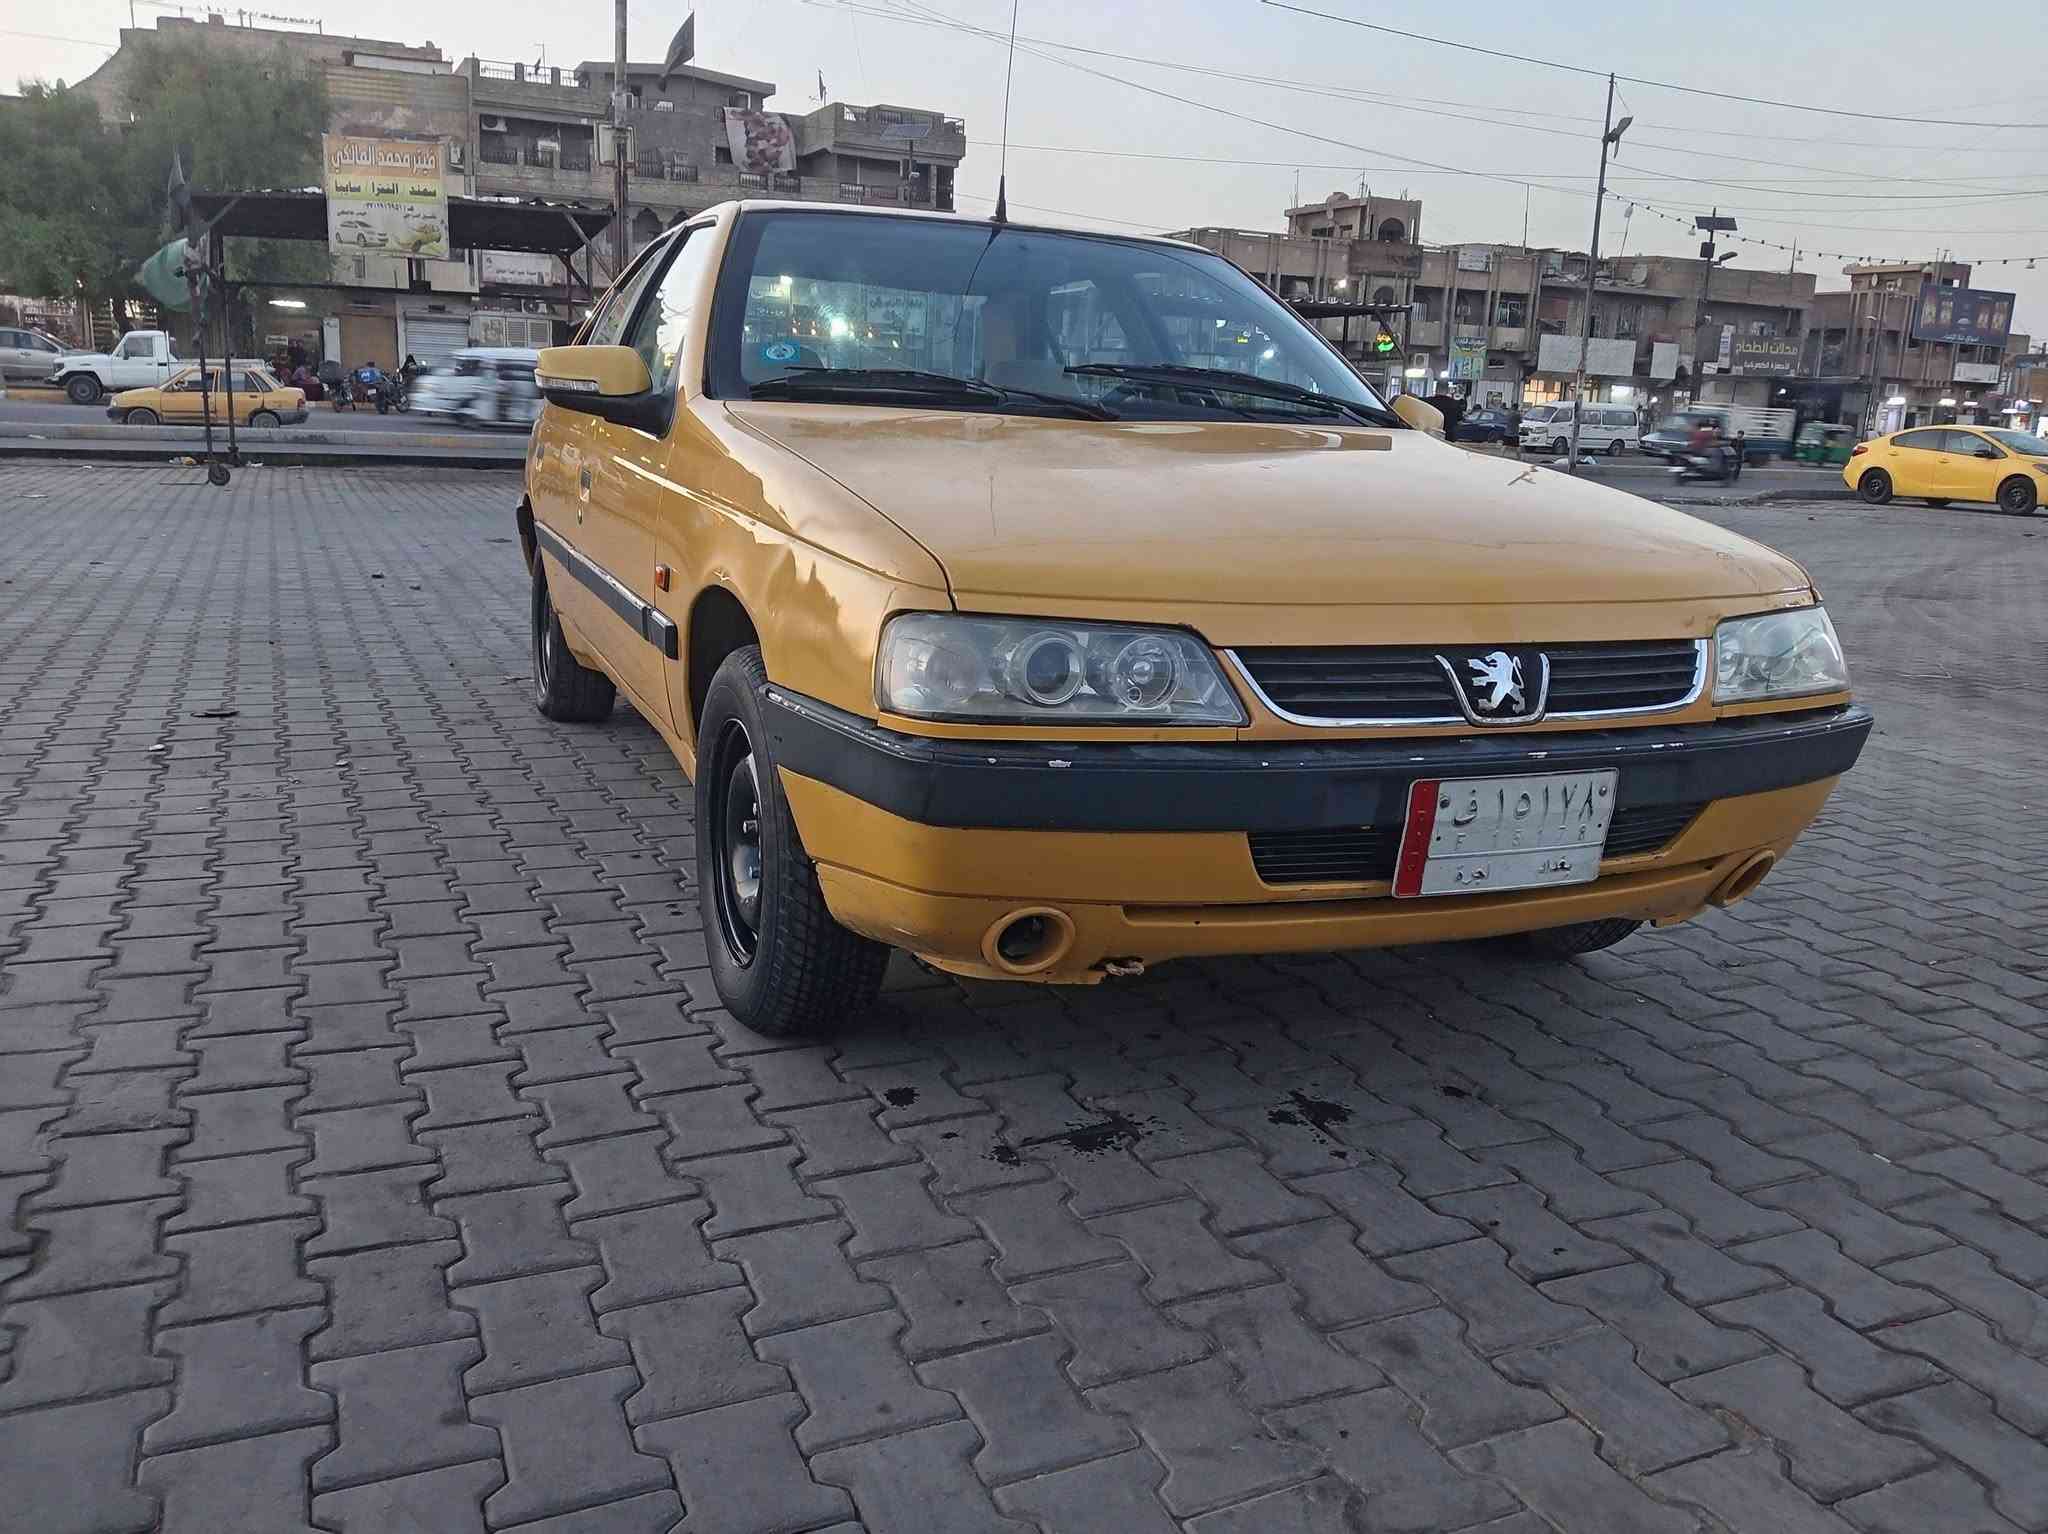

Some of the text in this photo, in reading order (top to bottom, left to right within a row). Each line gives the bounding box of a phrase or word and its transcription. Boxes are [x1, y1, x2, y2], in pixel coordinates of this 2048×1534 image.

[331, 144, 375, 174] المالكي
[378, 150, 410, 168] محمد
[1537, 856, 1573, 878] بغداد
